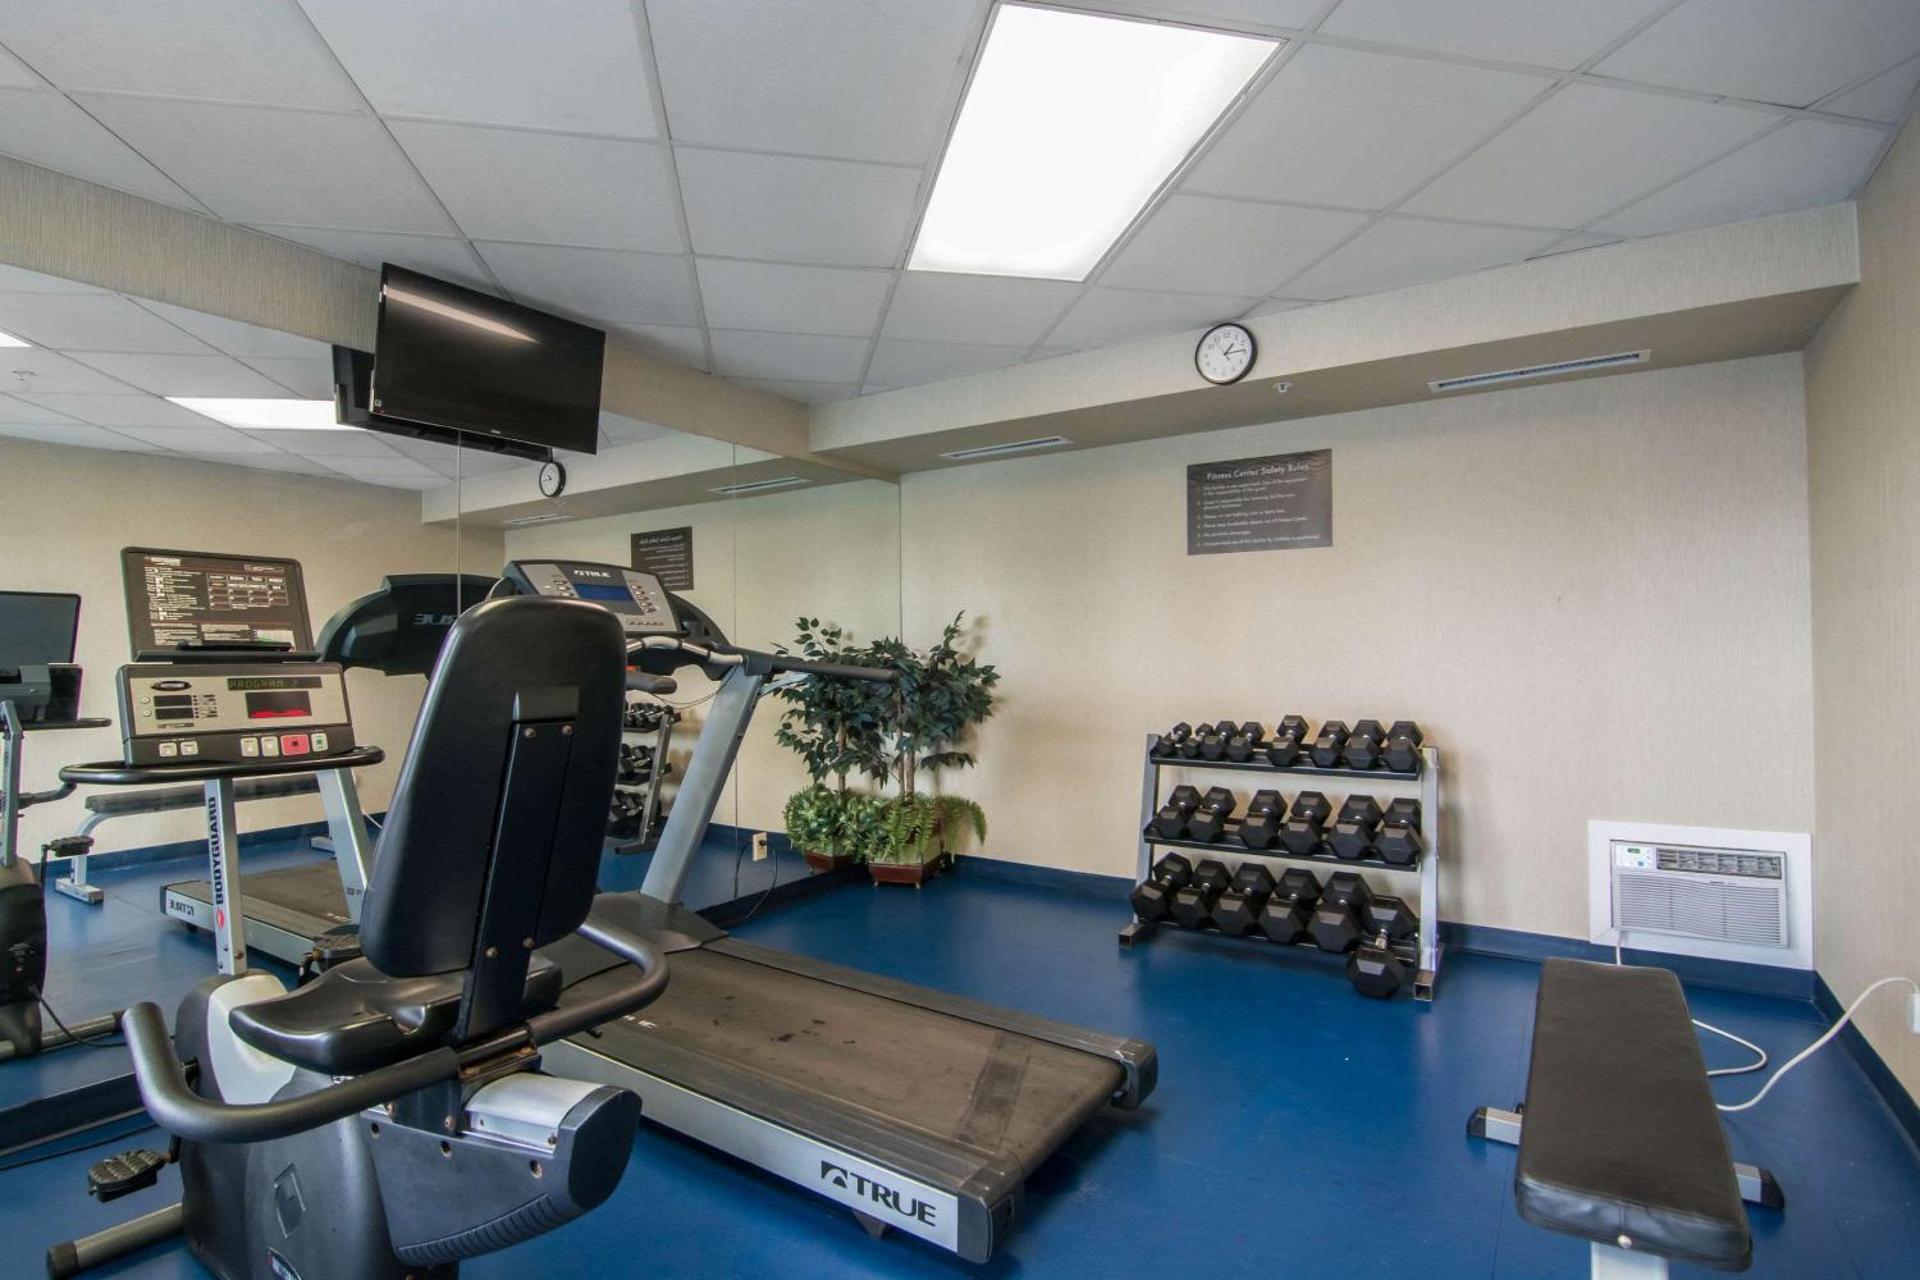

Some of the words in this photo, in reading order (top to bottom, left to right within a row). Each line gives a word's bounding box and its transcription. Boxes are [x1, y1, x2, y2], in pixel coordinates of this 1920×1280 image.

[1233, 468, 1258, 478] Center
[1261, 465, 1285, 476] Safety
[1287, 462, 1311, 472] Rules
[208, 796, 224, 905] BODYGUARD
[850, 1172, 937, 1227] TRUE
